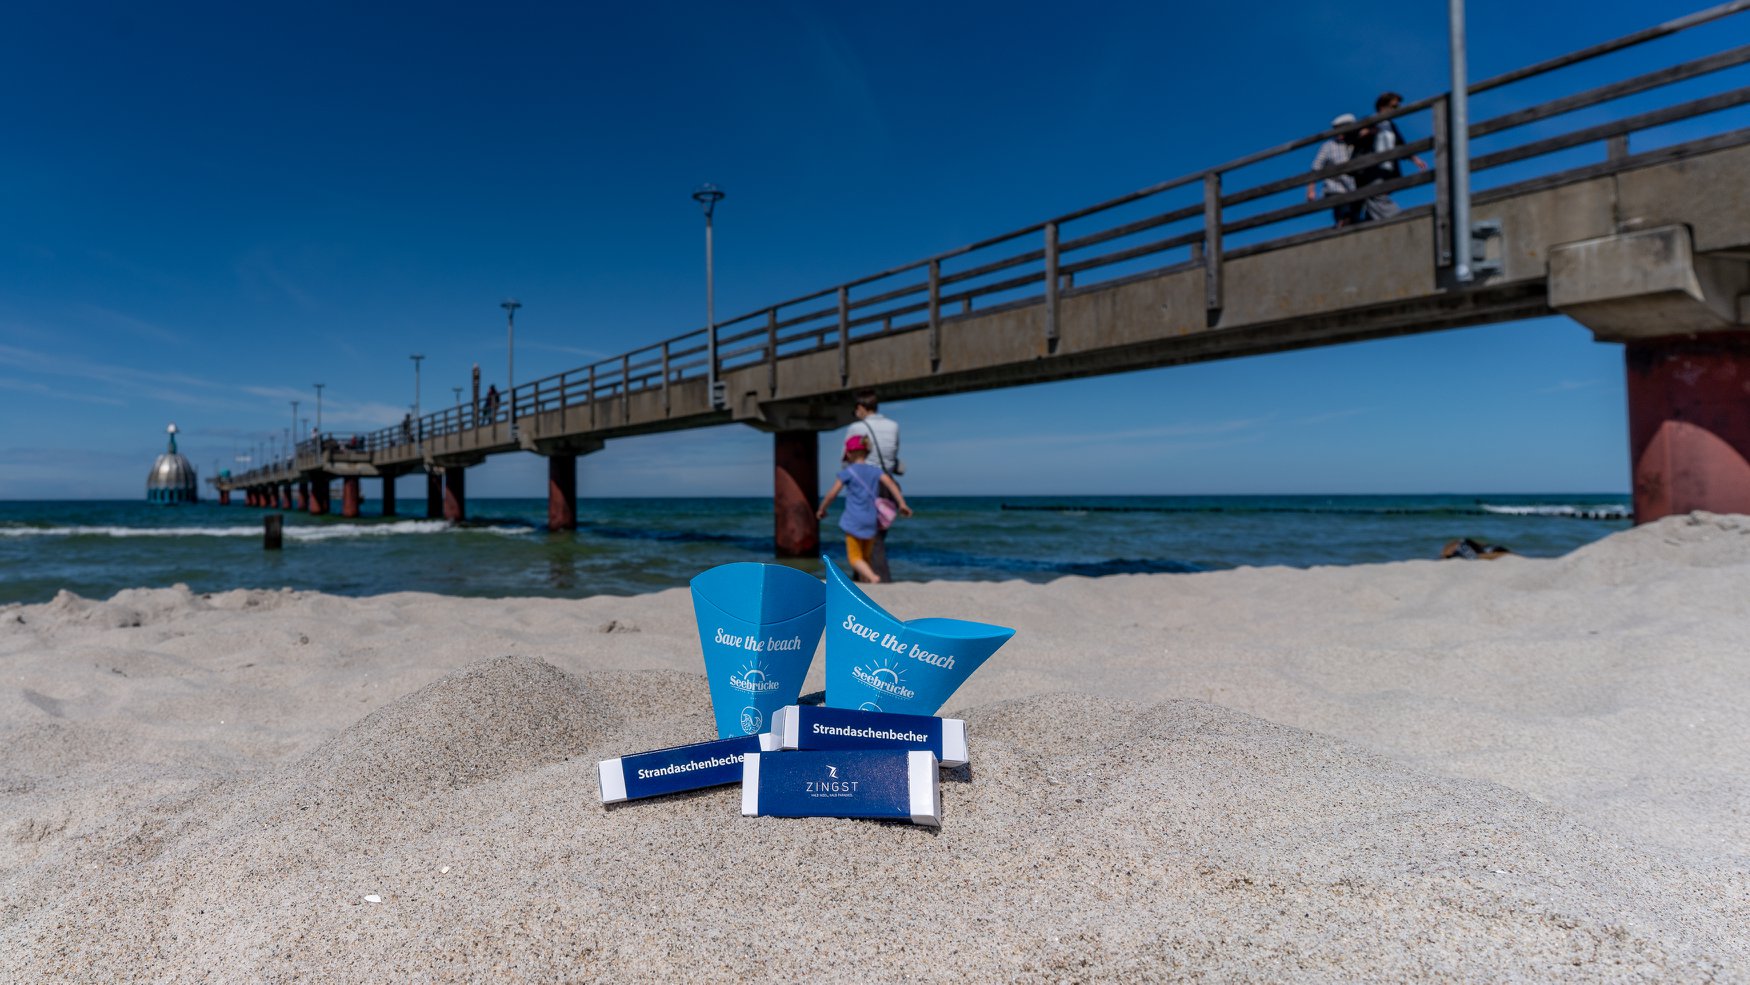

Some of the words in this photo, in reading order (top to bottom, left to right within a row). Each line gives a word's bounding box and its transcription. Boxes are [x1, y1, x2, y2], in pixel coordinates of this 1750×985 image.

[715, 627, 743, 648] Save
[744, 635, 765, 652] the
[767, 635, 801, 652] beach
[842, 614, 880, 642] Save
[880, 633, 908, 654] the
[908, 643, 956, 670] beach
[729, 675, 780, 691] Seebrücke
[852, 666, 915, 699] Seebrücke
[812, 723, 928, 743] Strandaschenbecher
[637, 753, 744, 779] Strandaschenbeche
[806, 781, 859, 792] ZINGST
